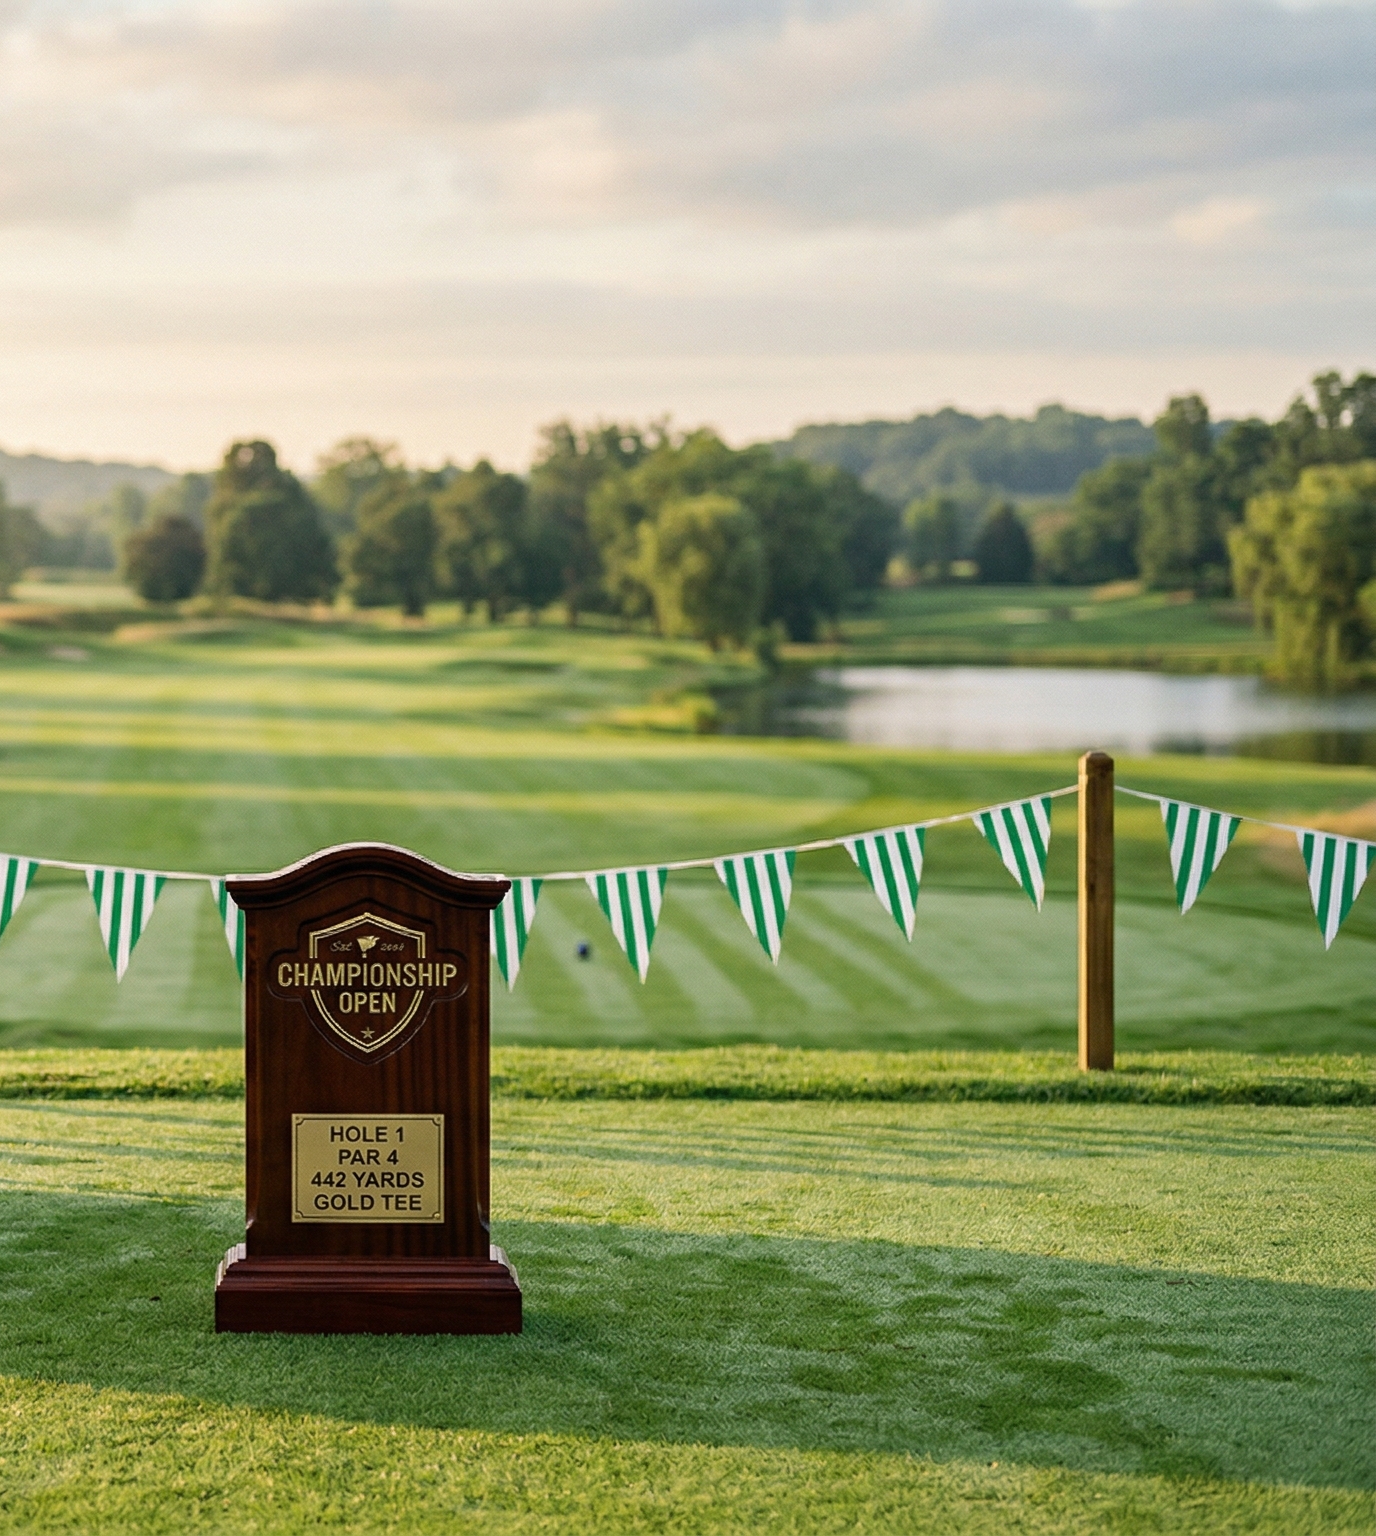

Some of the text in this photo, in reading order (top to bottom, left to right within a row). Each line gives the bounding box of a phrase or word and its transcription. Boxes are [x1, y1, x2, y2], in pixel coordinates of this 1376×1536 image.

[278, 962, 457, 987] CHAMPIONSHIP
[339, 991, 396, 1014] OPEN
[330, 1126, 404, 1142] HOLE 1
[338, 1150, 399, 1165] PAR 4
[311, 1172, 424, 1188] 442 YARDS
[314, 1194, 422, 1210] GOLD TEE
